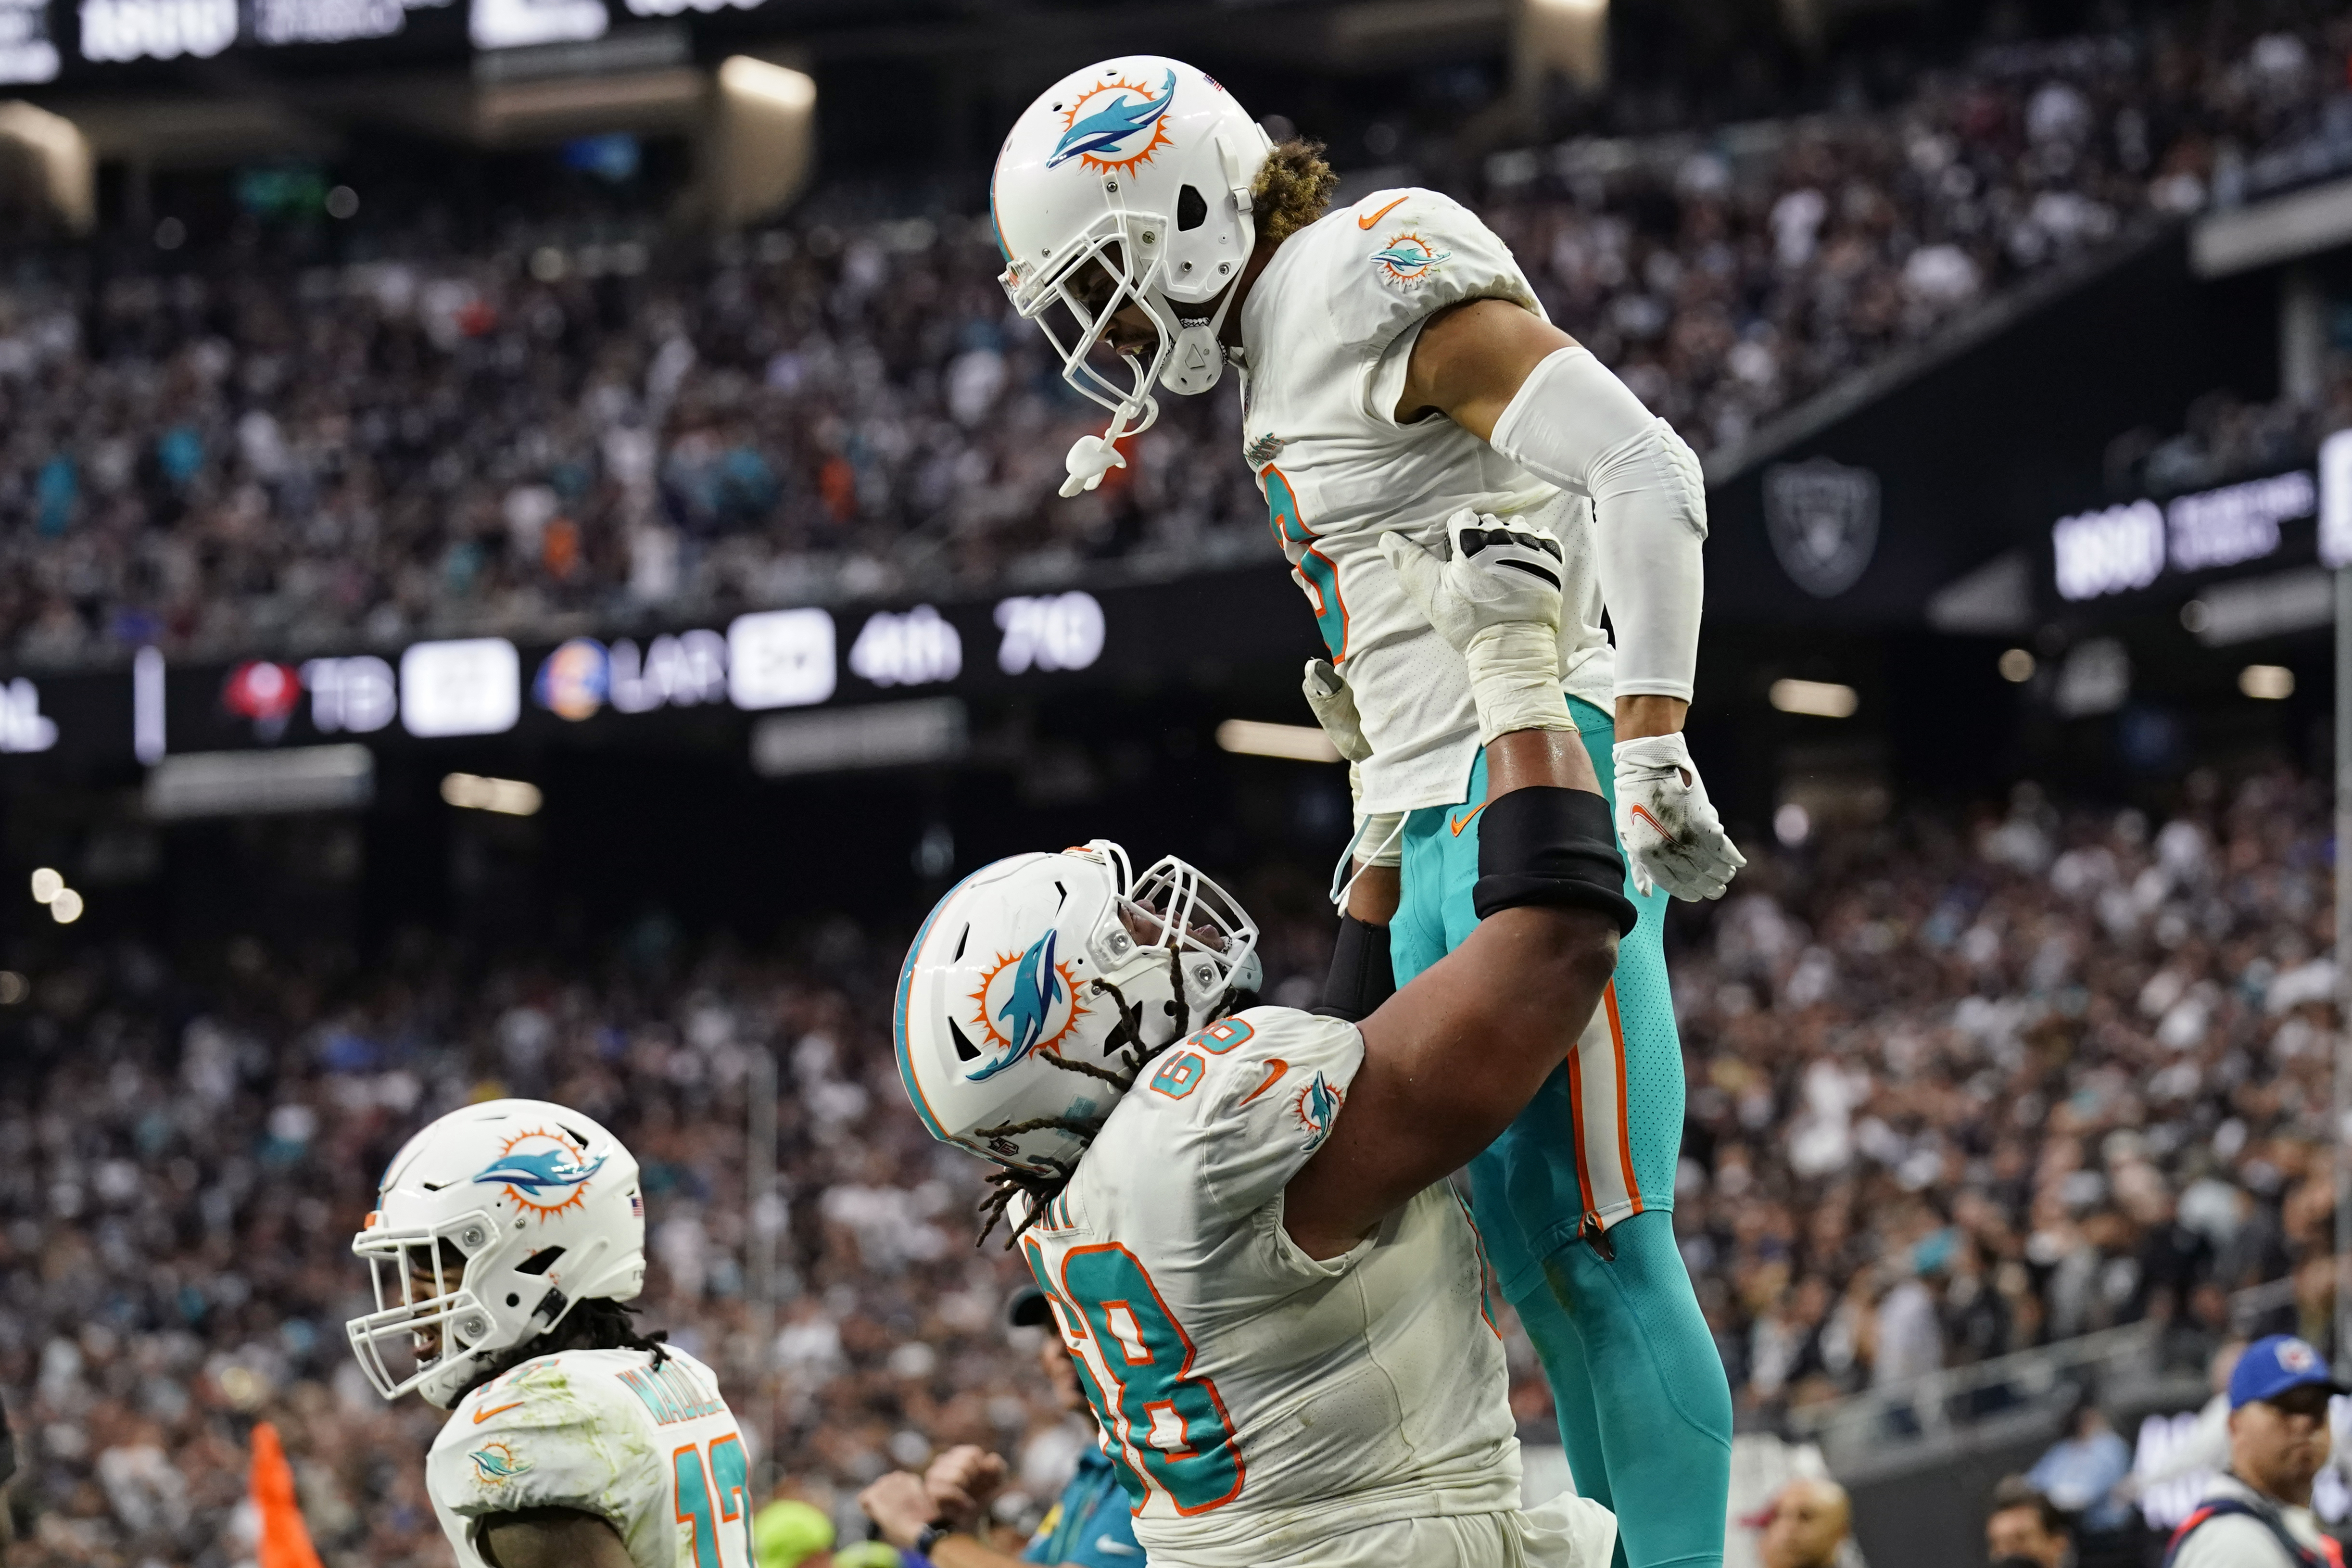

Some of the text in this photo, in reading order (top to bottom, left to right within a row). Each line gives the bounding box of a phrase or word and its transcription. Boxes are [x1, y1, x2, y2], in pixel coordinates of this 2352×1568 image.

[609, 628, 727, 713] LAR
[848, 604, 962, 688] 4th
[1149, 1014, 1255, 1100] 68
